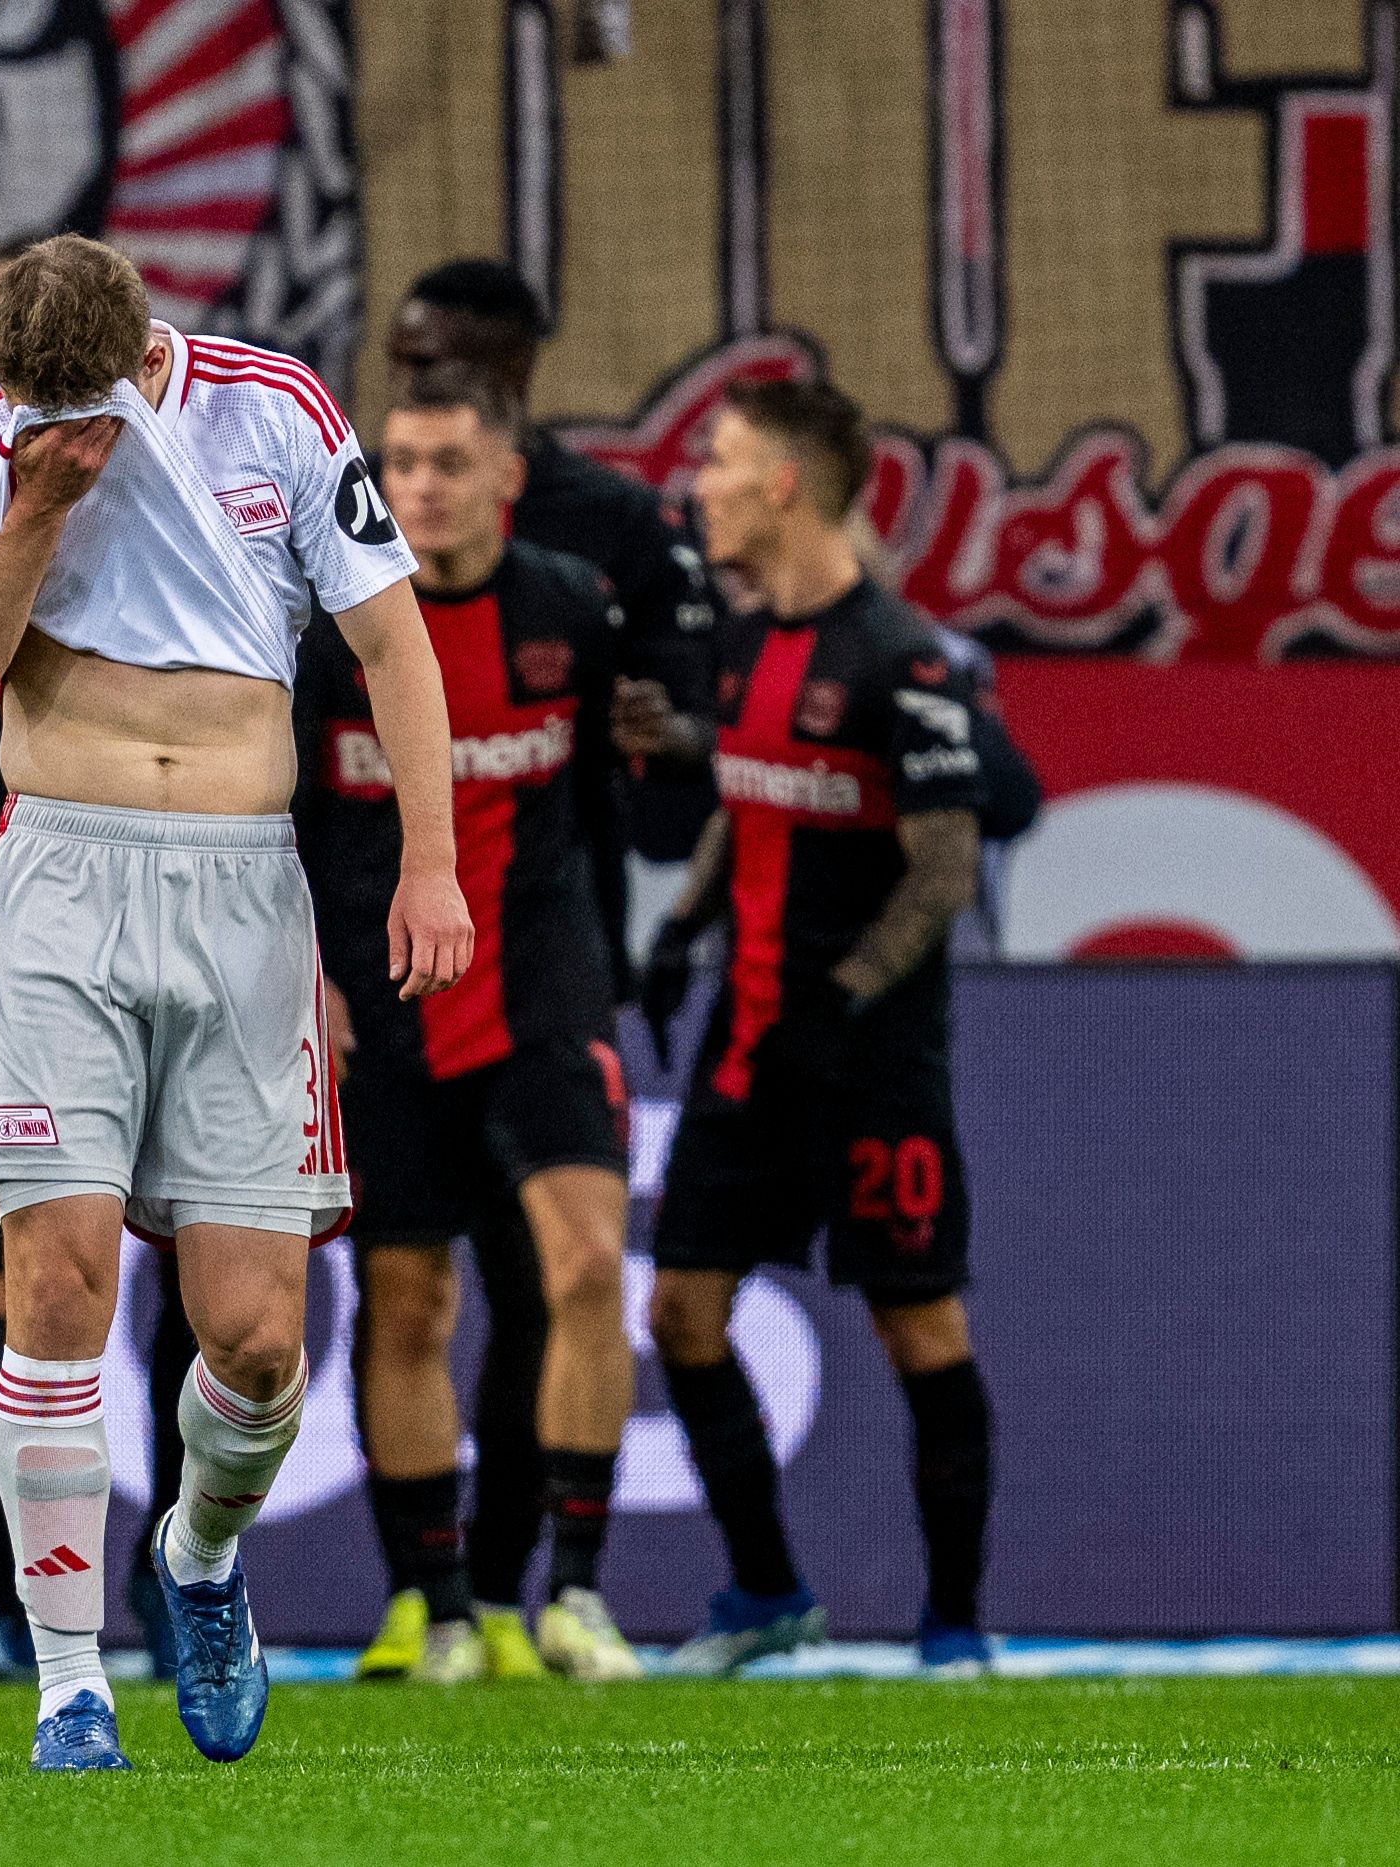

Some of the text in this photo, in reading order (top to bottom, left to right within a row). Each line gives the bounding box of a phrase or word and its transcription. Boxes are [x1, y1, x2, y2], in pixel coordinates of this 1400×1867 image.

[240, 499, 281, 525] UNION
[301, 1037, 319, 1138] 3
[16, 1120, 50, 1136] UNION
[849, 1134, 943, 1219] 20
